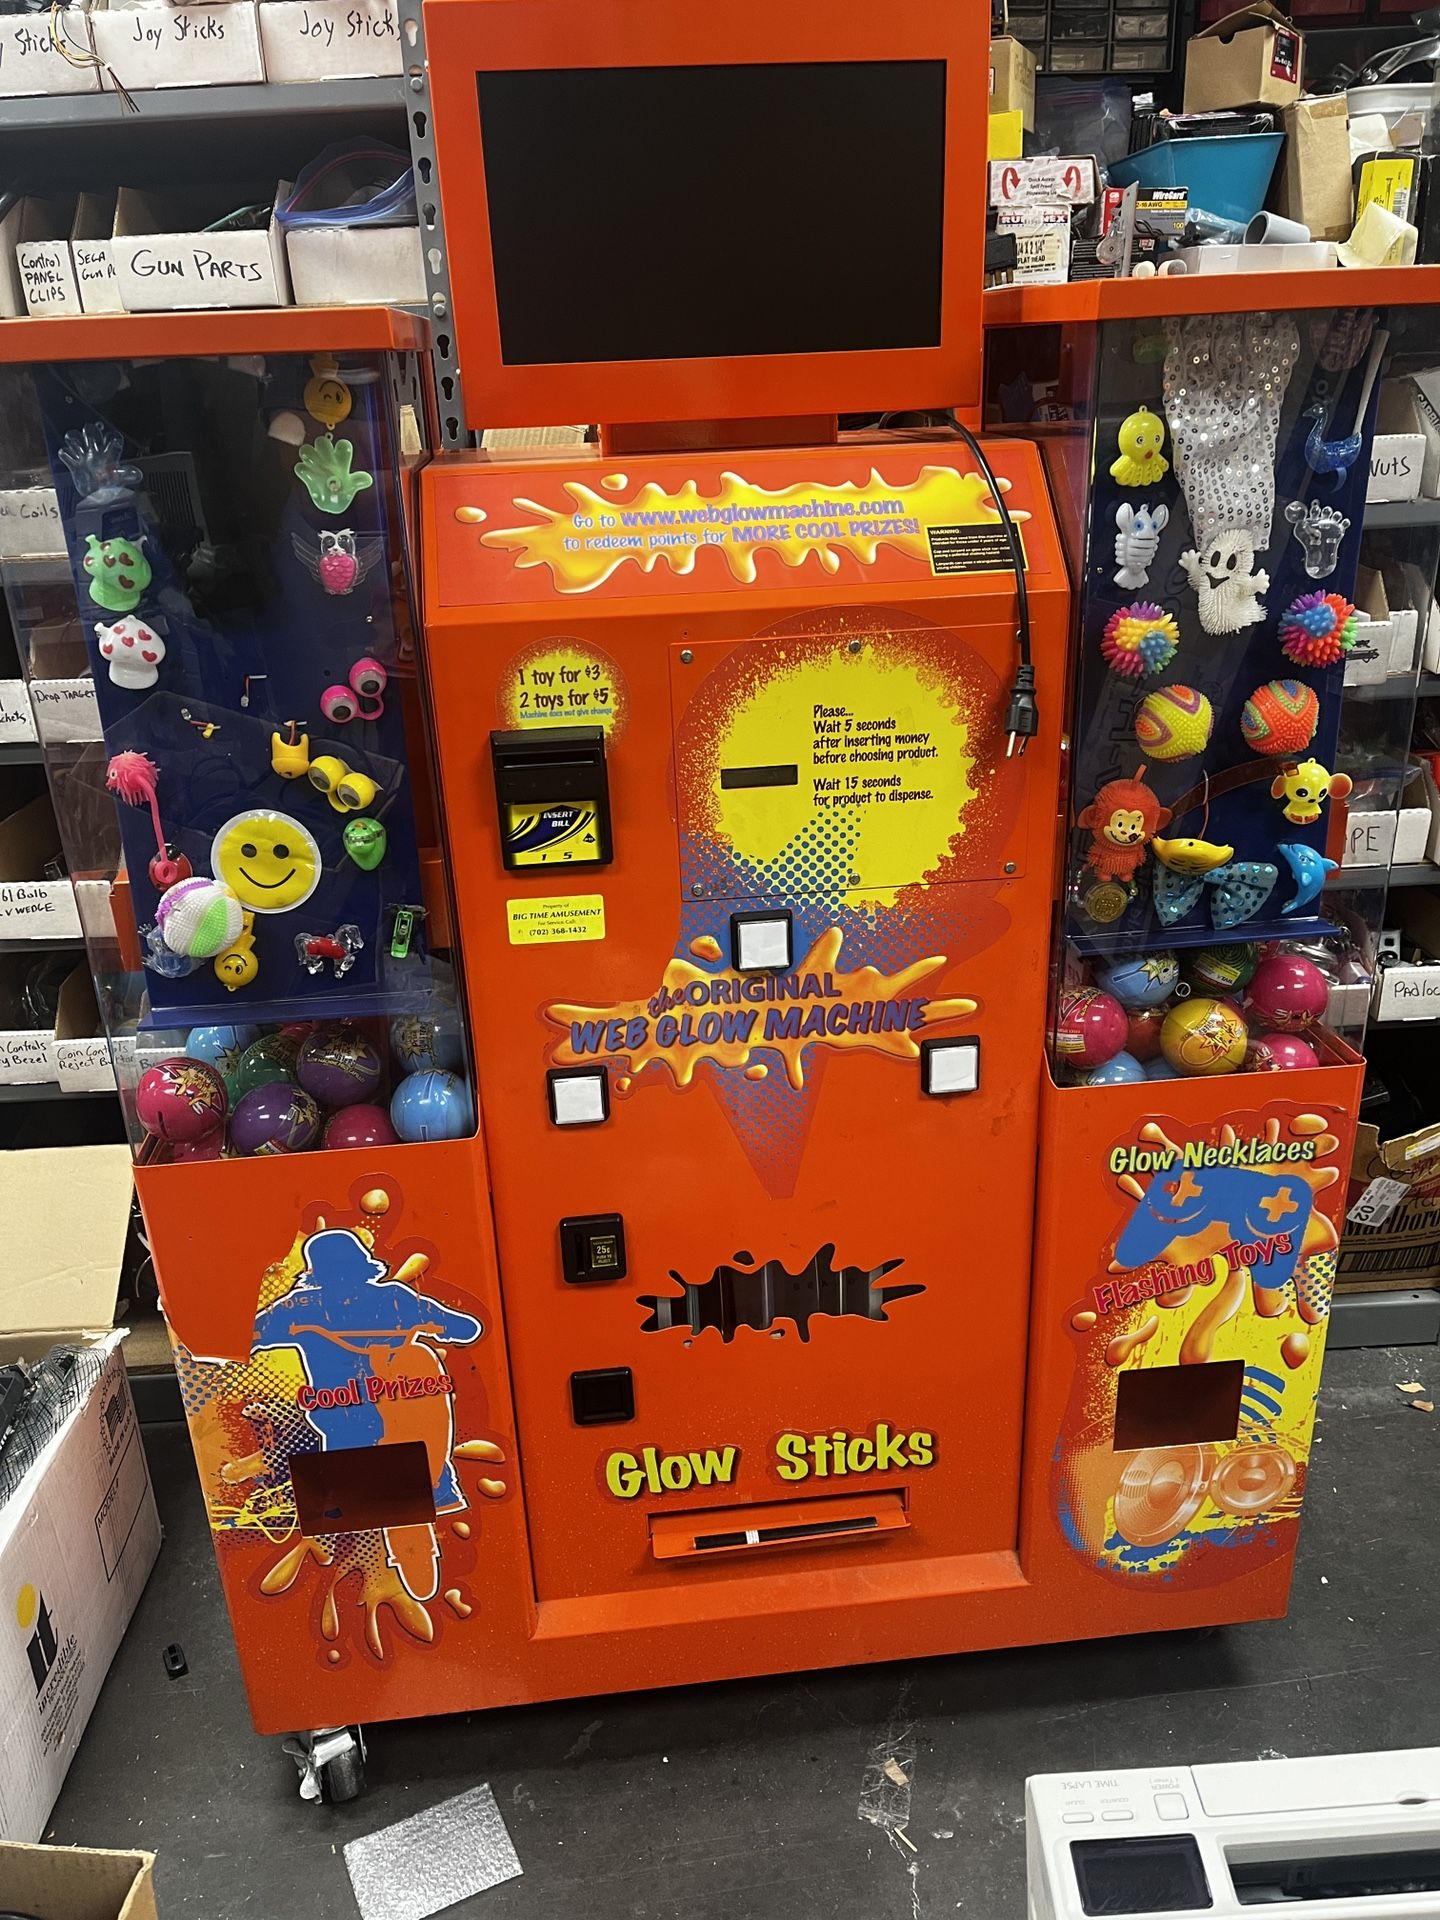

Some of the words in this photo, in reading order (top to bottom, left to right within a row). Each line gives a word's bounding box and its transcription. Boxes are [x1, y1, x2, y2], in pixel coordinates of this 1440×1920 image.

[133, 17, 162, 50] Joy
[174, 15, 225, 41] Sticks
[300, 10, 334, 47] Joy
[25, 270, 64, 285] PANEL
[29, 286, 66, 304] CLIPS
[573, 514, 593, 528] Go
[599, 513, 616, 528] to
[620, 498, 905, 527] www.webglowmachine.com
[563, 536, 580, 550] to
[586, 535, 643, 549] redeem
[649, 531, 697, 548] points
[703, 528, 728, 544] for
[731, 524, 791, 542] MORE
[794, 521, 846, 539] COOL
[848, 518, 920, 537] PRIZES!
[518, 668, 525, 686] 1
[531, 669, 555, 687] toy
[559, 665, 581, 683] for
[585, 664, 600, 680] $3
[519, 691, 530, 708] 2
[533, 692, 564, 711] toys
[567, 688, 590, 706] for
[593, 687, 609, 704] $5
[813, 704, 854, 718] Please...
[813, 720, 841, 734] Wait
[844, 719, 853, 732] 5
[856, 717, 896, 731] seconds
[813, 735, 841, 750] after
[844, 733, 891, 748] inserting
[895, 732, 930, 745] money
[813, 750, 847, 765] before
[849, 748, 894, 763] choosing
[897, 746, 938, 762] product.
[813, 778, 841, 792] Wait
[845, 776, 859, 789] 15
[862, 774, 901, 788] seconds
[813, 793, 830, 807] for
[832, 791, 872, 807] product
[875, 791, 886, 802] to
[889, 789, 934, 803] dispense.
[543, 810, 573, 819] INSERT
[541, 853, 547, 861] 1
[563, 851, 573, 860] 5
[512, 913, 528, 921] BIG
[530, 911, 549, 919] TIME
[550, 908, 602, 918] AMUSEMENT
[529, 928, 549, 936] (702)
[551, 926, 587, 935] 368-1432
[648, 983, 685, 1019] the
[684, 973, 842, 1006] ORIGINAL
[570, 1013, 648, 1055] WEB
[655, 1008, 759, 1049] GLOW
[763, 998, 930, 1042] MACHINE
[1109, 1146, 1175, 1174] Glow
[1182, 1137, 1315, 1168] Necklaces
[1092, 1255, 1215, 1315] Flashing
[1219, 1233, 1292, 1271] Toys
[297, 1378, 359, 1412] Cool
[367, 1370, 454, 1405] Prizes
[605, 1446, 736, 1498] Glow
[775, 1423, 934, 1481] Sticks
